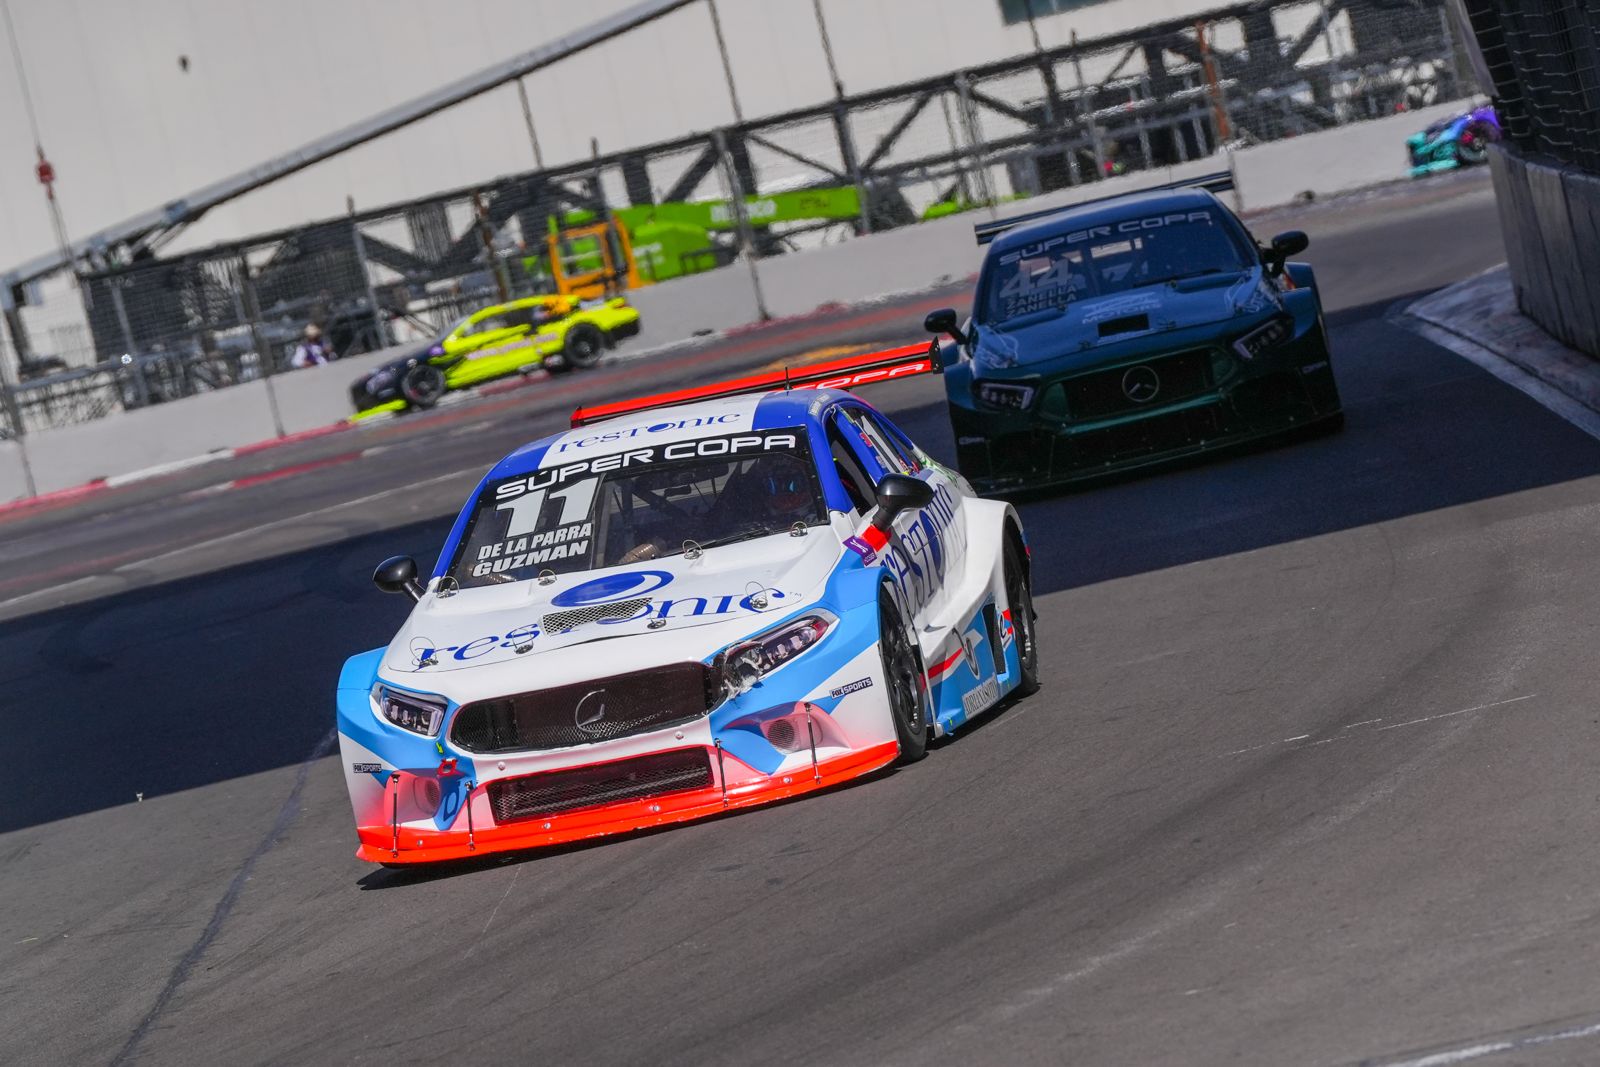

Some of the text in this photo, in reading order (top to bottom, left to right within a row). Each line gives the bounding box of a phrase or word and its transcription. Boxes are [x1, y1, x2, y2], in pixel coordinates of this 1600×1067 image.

[999, 211, 1211, 266] SUPER COPA
[999, 259, 1074, 298] 44
[496, 434, 797, 500] SUPER COPA
[495, 477, 600, 539] 11
[472, 540, 589, 578] GUZMAN
[478, 522, 593, 561] DE LA PARRA
[843, 678, 872, 695] SPORTS
[362, 763, 381, 773] SPORTS
